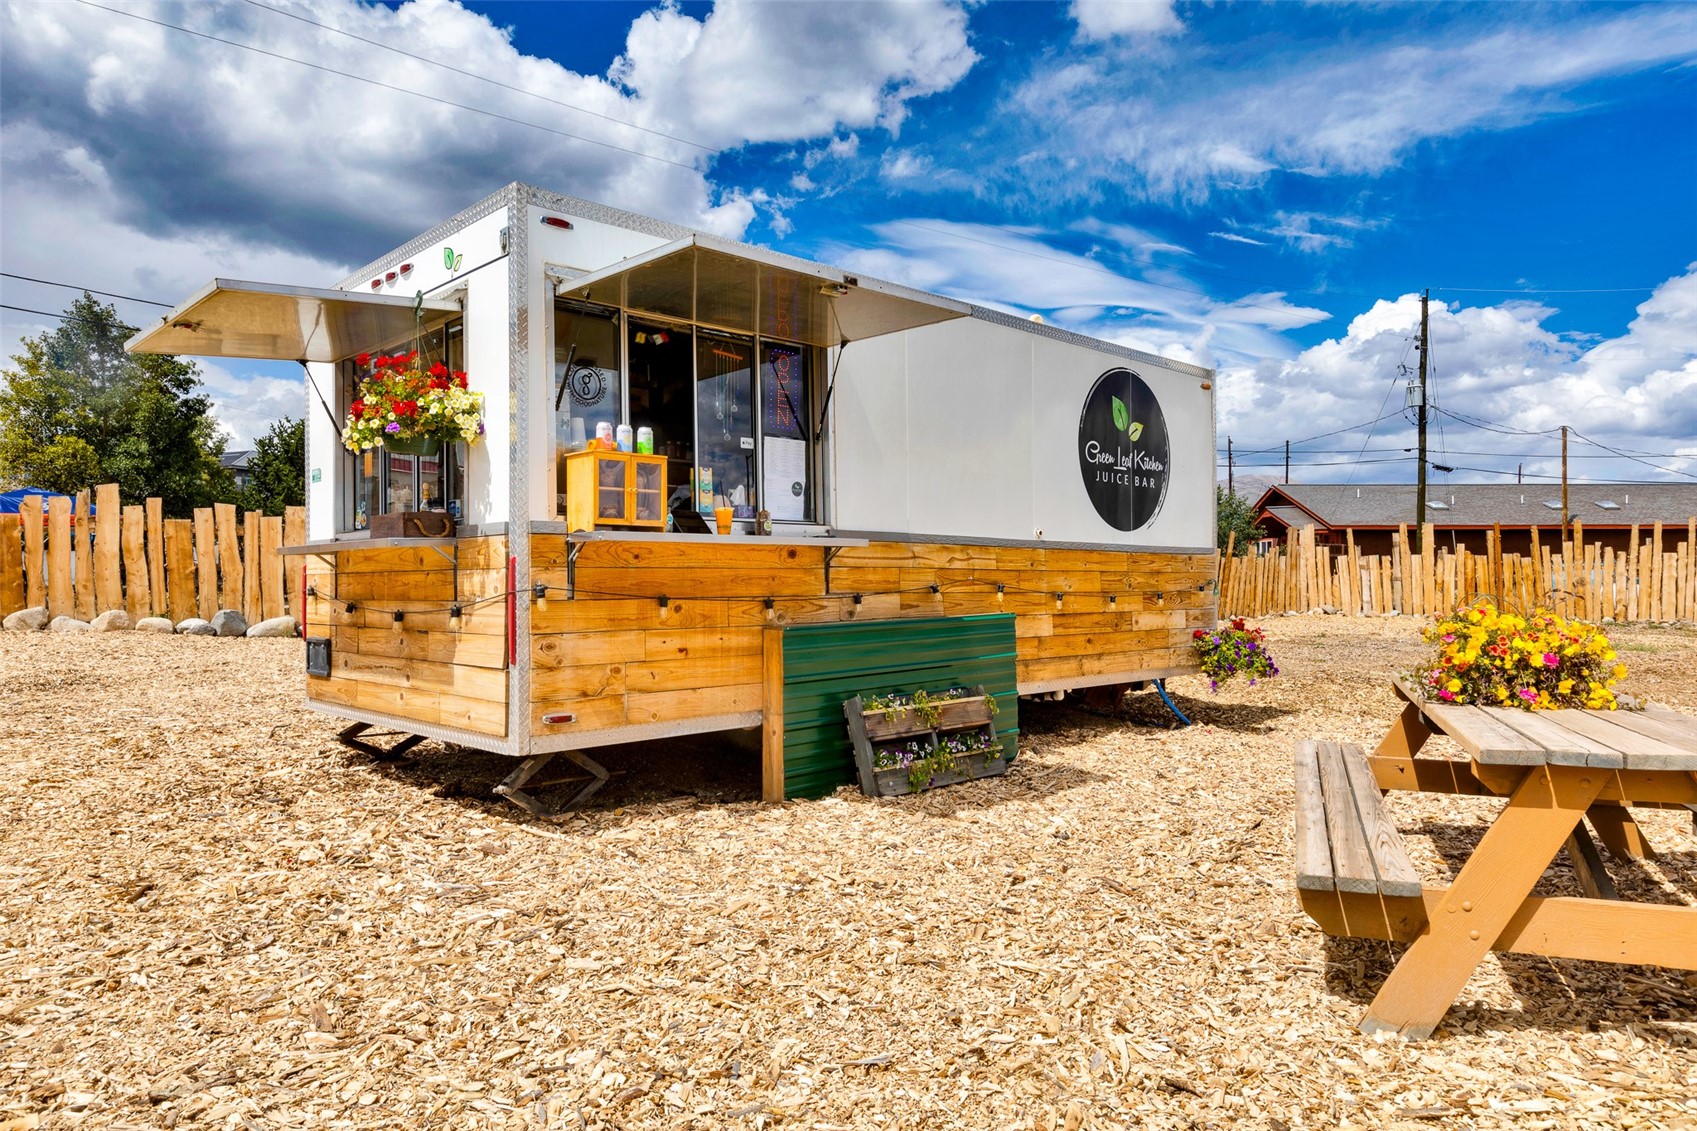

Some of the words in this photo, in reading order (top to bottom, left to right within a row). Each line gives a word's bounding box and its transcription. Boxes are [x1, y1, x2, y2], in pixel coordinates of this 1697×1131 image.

[575, 387, 608, 407] GOODNATURE
[776, 354, 790, 427] OPEN
[1085, 440, 1115, 465] Green
[1113, 446, 1133, 471] Leaf
[1134, 449, 1164, 472] Kitchen
[1096, 470, 1129, 485] JUICE
[1134, 475, 1155, 489] BAR
